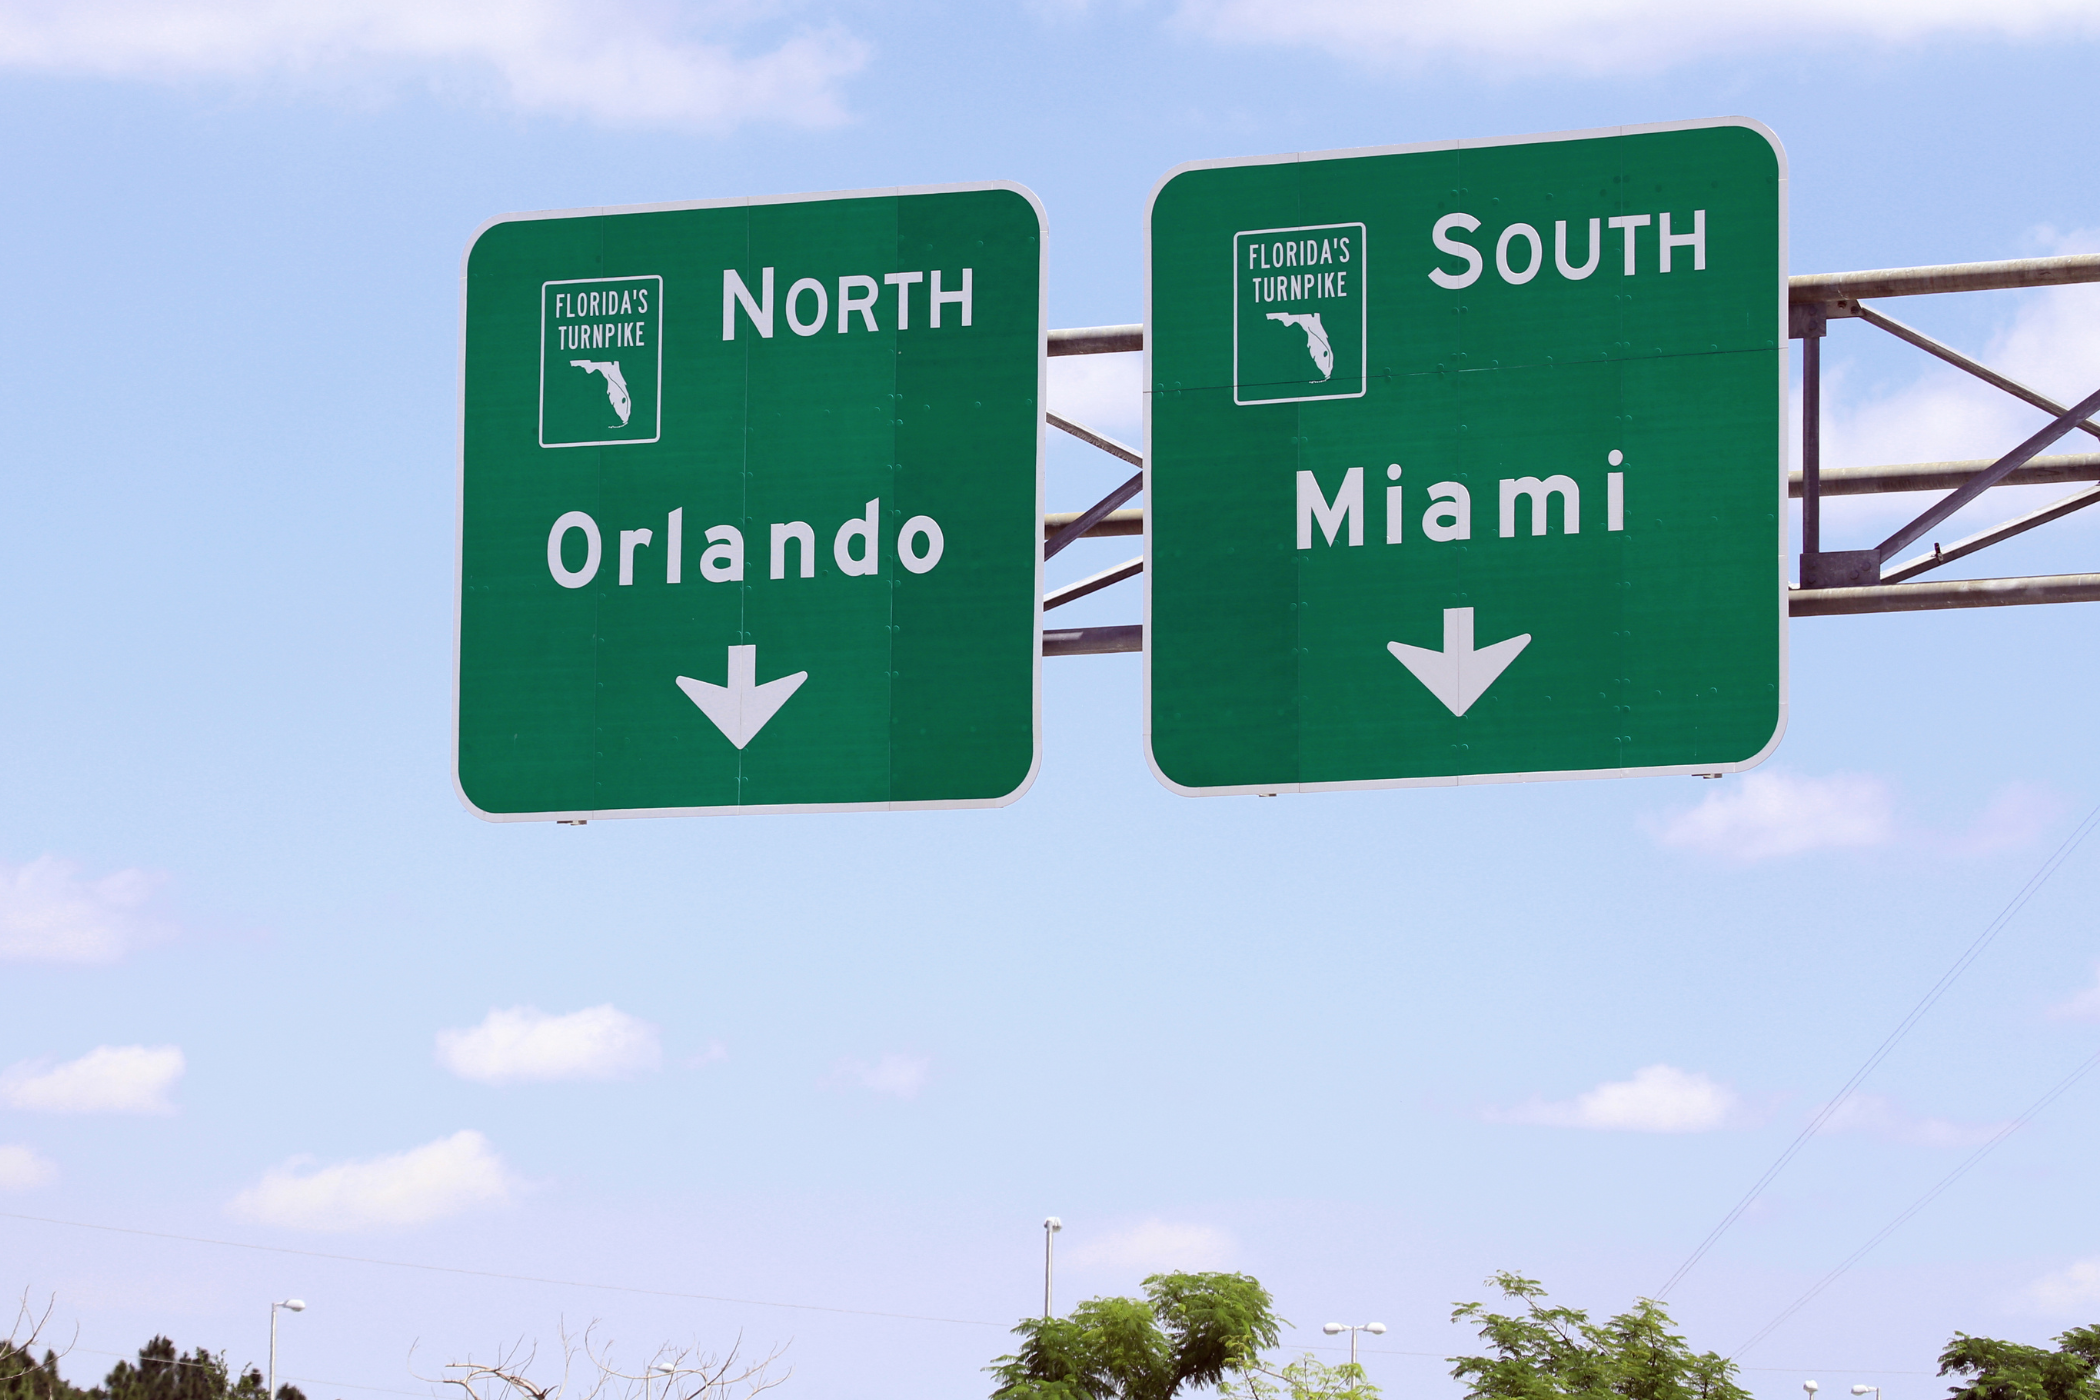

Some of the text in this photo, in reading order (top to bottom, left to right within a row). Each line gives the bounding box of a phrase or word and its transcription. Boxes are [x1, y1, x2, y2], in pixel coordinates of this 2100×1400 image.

[1249, 236, 1351, 270] FLORIDA'S
[1428, 209, 1706, 290] SOUTH
[555, 288, 649, 319] FLORIDA'S
[722, 266, 973, 341] NORTH
[1252, 271, 1347, 303] TURNPIKE
[558, 321, 646, 351] TURNPIKE
[1296, 449, 1624, 550] Miami
[547, 497, 945, 589] Orlando
